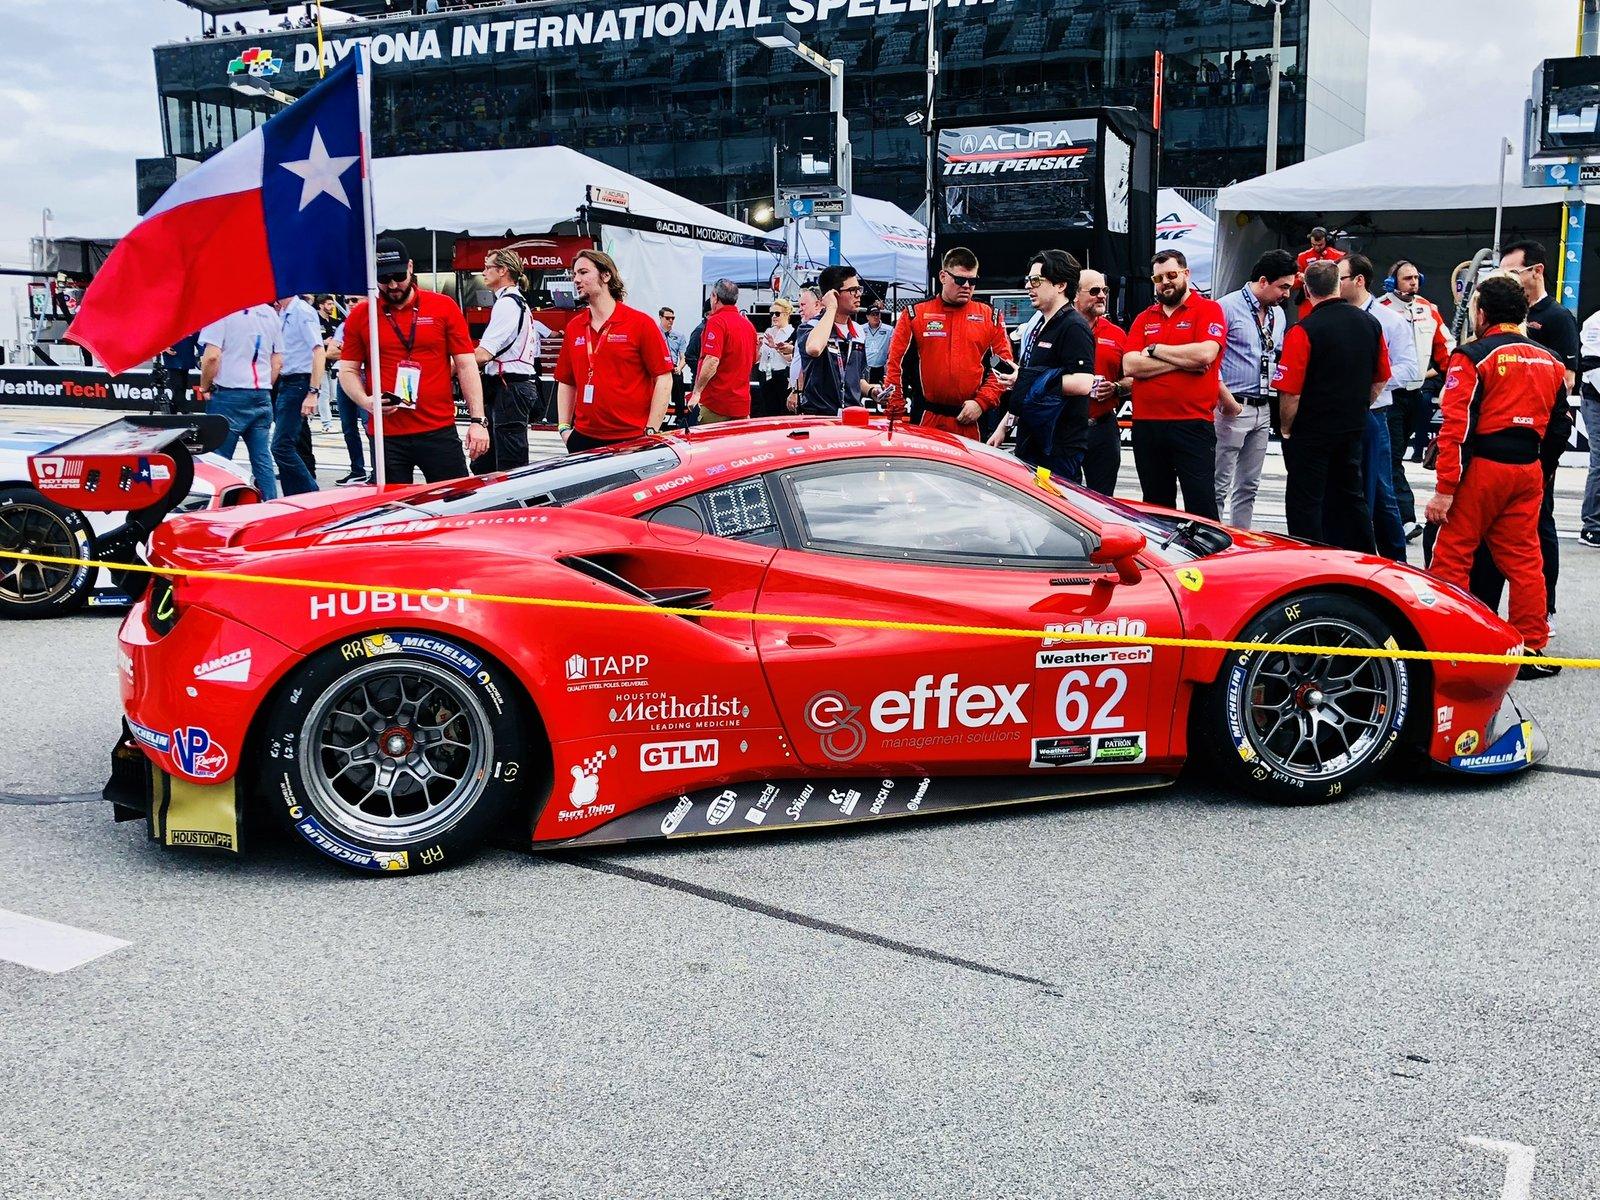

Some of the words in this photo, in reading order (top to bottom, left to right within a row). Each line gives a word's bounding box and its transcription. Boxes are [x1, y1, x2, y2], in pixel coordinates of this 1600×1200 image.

[294, 29, 441, 72] DAYTONA
[451, 0, 772, 57] INTERNATIONAL
[978, 129, 1074, 152] ACURA
[942, 160, 997, 176] TEAM
[1000, 155, 1085, 173] PENSKE
[595, 188, 601, 201] 7
[662, 222, 690, 236] ACURA
[696, 226, 744, 246] MOTORSPORTS
[530, 255, 563, 266] CORSA
[809, 439, 866, 452] VILANDER
[730, 452, 775, 470] CALADO
[654, 475, 694, 494] RIGON
[445, 515, 549, 528] LUBRICANTS
[76, 546, 90, 587] MICELIN
[310, 588, 472, 620] HUBLOT
[1284, 603, 1301, 622] RF
[1041, 617, 1147, 647] pakelo
[193, 647, 252, 676] CAMOZZI
[341, 640, 364, 661] RR
[402, 636, 477, 670] MICHELIN
[590, 654, 649, 677] TAPP
[616, 692, 667, 701] HOUSTON
[869, 673, 1031, 734] effex
[1055, 667, 1128, 732] 62
[1228, 669, 1242, 738] MICHELIN
[1396, 660, 1408, 727] MICHELIN
[616, 694, 742, 722] Methodist
[650, 722, 691, 731] LEADING
[695, 719, 741, 729] MEDICINE
[881, 734, 963, 749] management
[966, 728, 1021, 744] solutions
[1104, 739, 1132, 748] PATRÓN
[173, 726, 210, 776] VP
[643, 743, 716, 767] GTLM
[1039, 746, 1089, 755] WeatherTech
[1460, 753, 1513, 766] MICHELIN
[756, 783, 775, 808] metal
[869, 788, 890, 814] BOSCH
[914, 777, 931, 804] brembo
[558, 808, 583, 819] Sure
[588, 803, 616, 815] Thing
[708, 790, 738, 826] HELLA
[173, 832, 215, 844] HOUSTON
[216, 835, 232, 847] PPF
[301, 823, 372, 865] MICHELIN
[419, 845, 444, 865] RR
